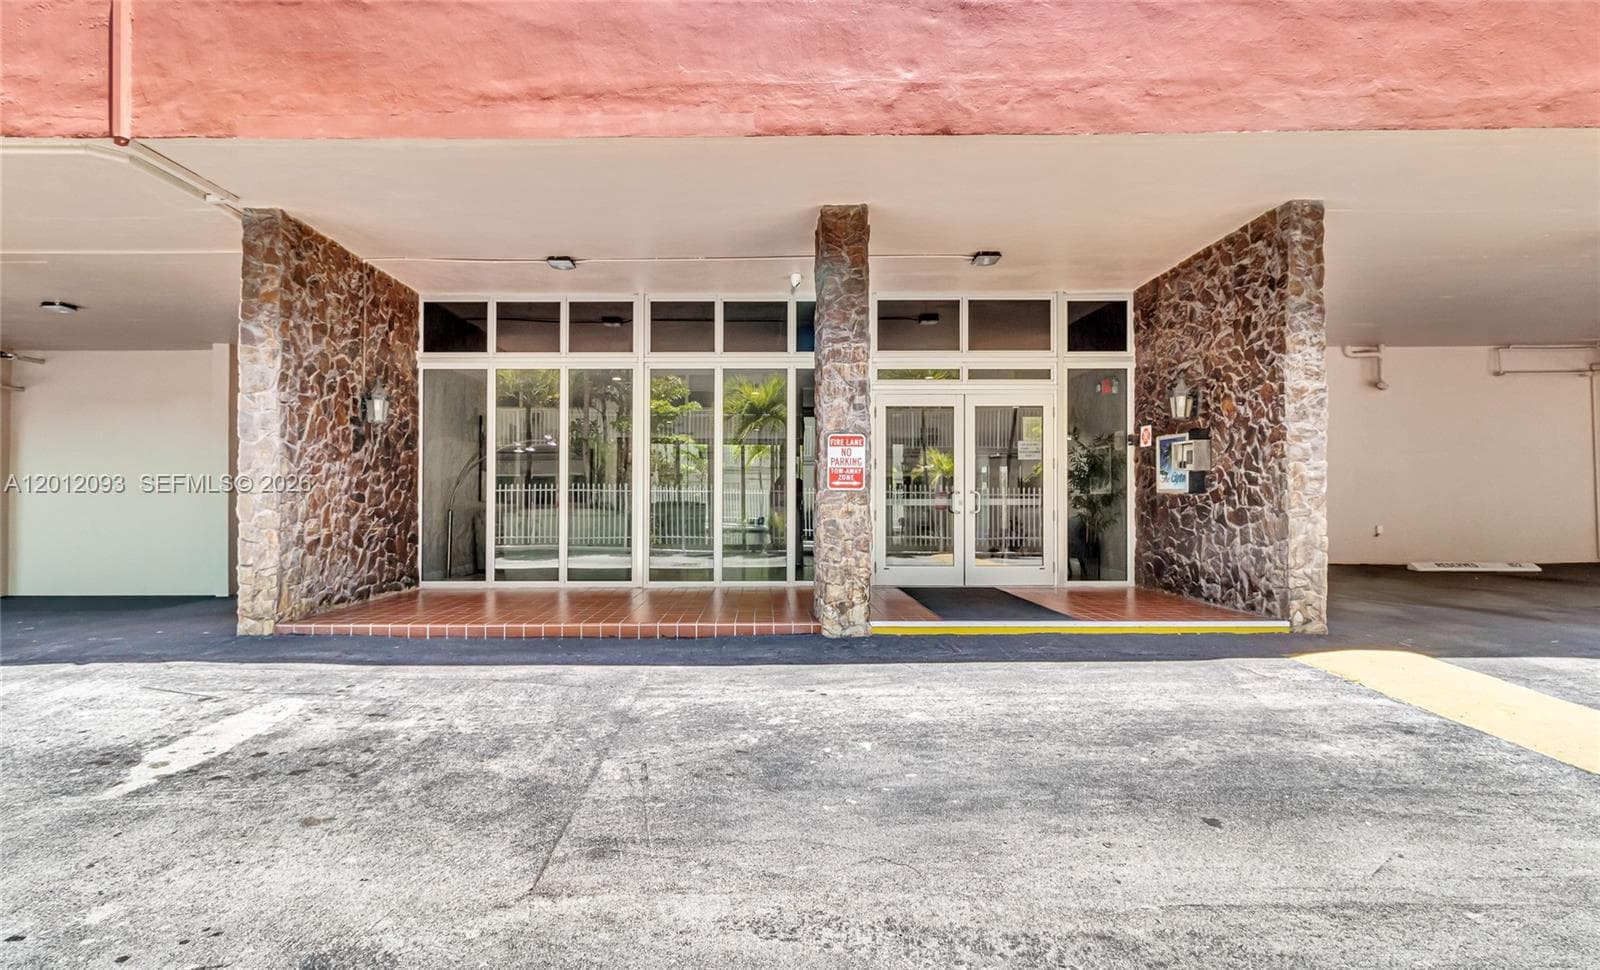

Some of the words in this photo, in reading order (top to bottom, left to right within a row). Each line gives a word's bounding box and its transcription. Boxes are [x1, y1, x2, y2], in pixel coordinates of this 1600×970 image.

[831, 438, 845, 446] FIRE
[847, 438, 864, 446] LANE
[841, 448, 851, 456] NO
[831, 457, 862, 466] PARKING
